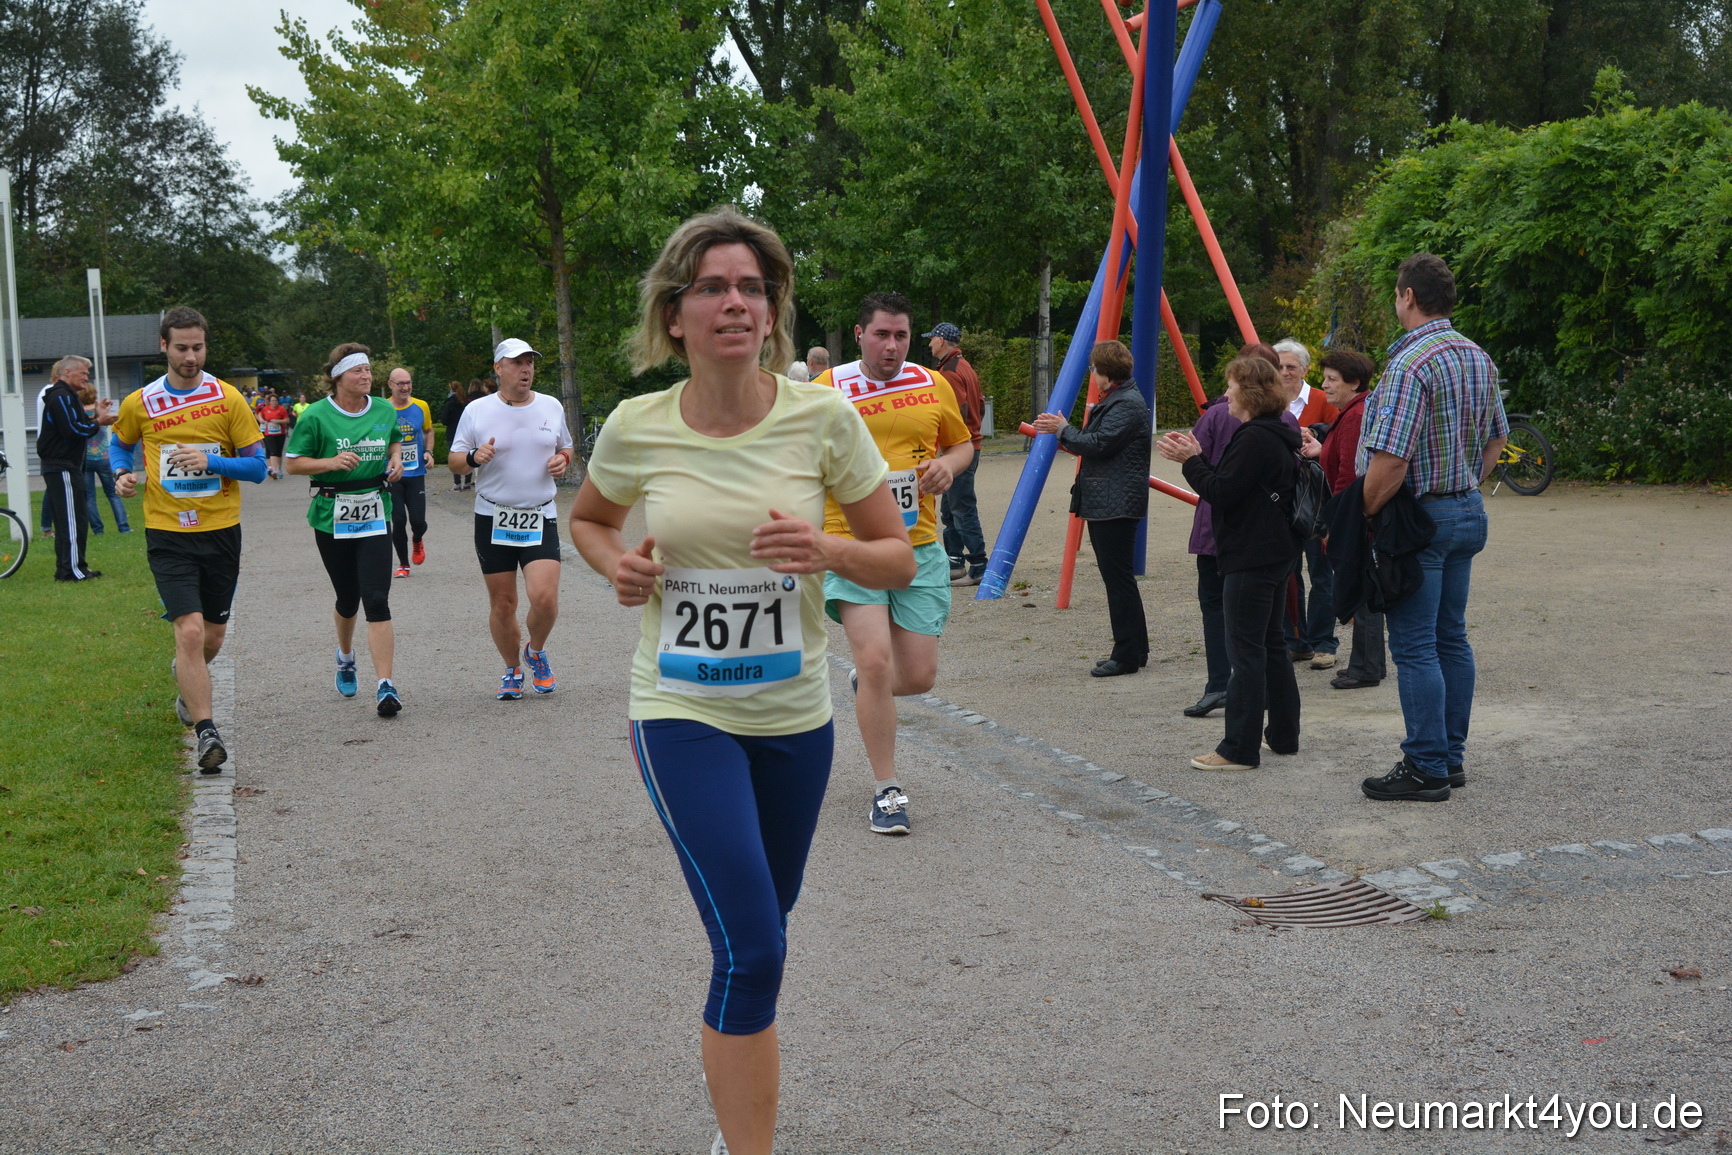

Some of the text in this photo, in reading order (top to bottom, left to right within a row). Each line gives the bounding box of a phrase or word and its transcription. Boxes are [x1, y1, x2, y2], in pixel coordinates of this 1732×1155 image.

[859, 393, 939, 417] AX BÖGL
[152, 404, 229, 433] MAX BÖGL
[174, 482, 209, 491] Matthias
[339, 502, 379, 521] 2421
[498, 511, 539, 530] 2422
[347, 523, 373, 532] Claudia
[505, 531, 530, 541] Herbert
[665, 579, 777, 595] PARTL Neumarkt
[674, 597, 784, 651] 2671
[697, 662, 763, 682] Sandra
